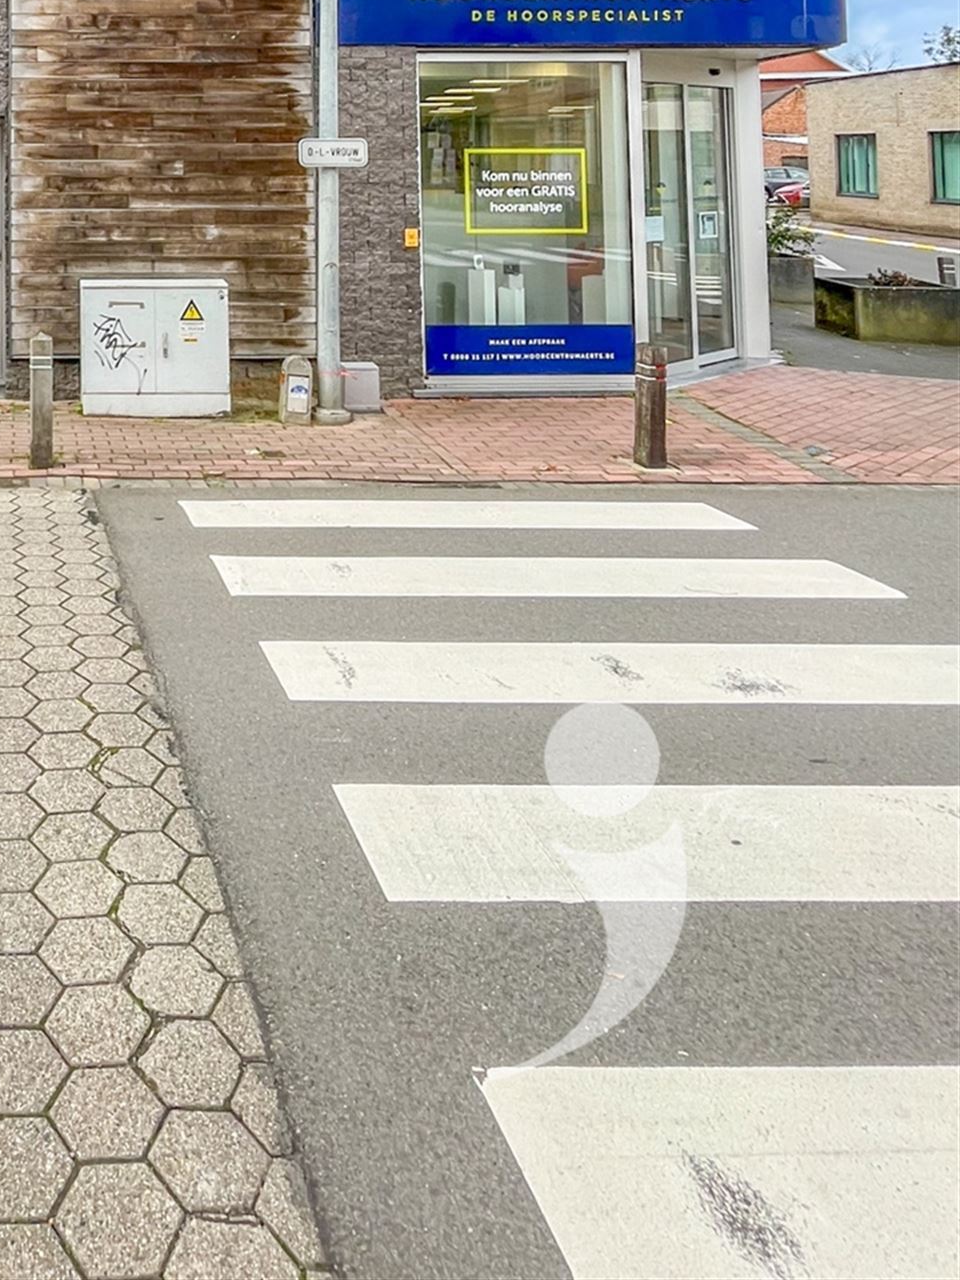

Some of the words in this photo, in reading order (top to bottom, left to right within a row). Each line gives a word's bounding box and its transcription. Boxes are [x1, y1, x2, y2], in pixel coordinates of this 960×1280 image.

[471, 10, 496, 22] DE
[507, 9, 685, 22] HOORSPECIALIST
[481, 170, 510, 182] Kom
[512, 171, 528, 182] nu
[530, 170, 573, 182] binnen
[476, 187, 504, 198] voor
[506, 187, 529, 198] een
[531, 185, 576, 197] GRATIS
[489, 201, 564, 216] hooranalyse
[488, 338, 510, 346] MAAK
[511, 338, 527, 346] EEN
[528, 338, 566, 346] AFSPRAAK
[442, 353, 449, 361] T
[501, 352, 616, 361] WWW.HOORCENTRUMAERTS.BE
